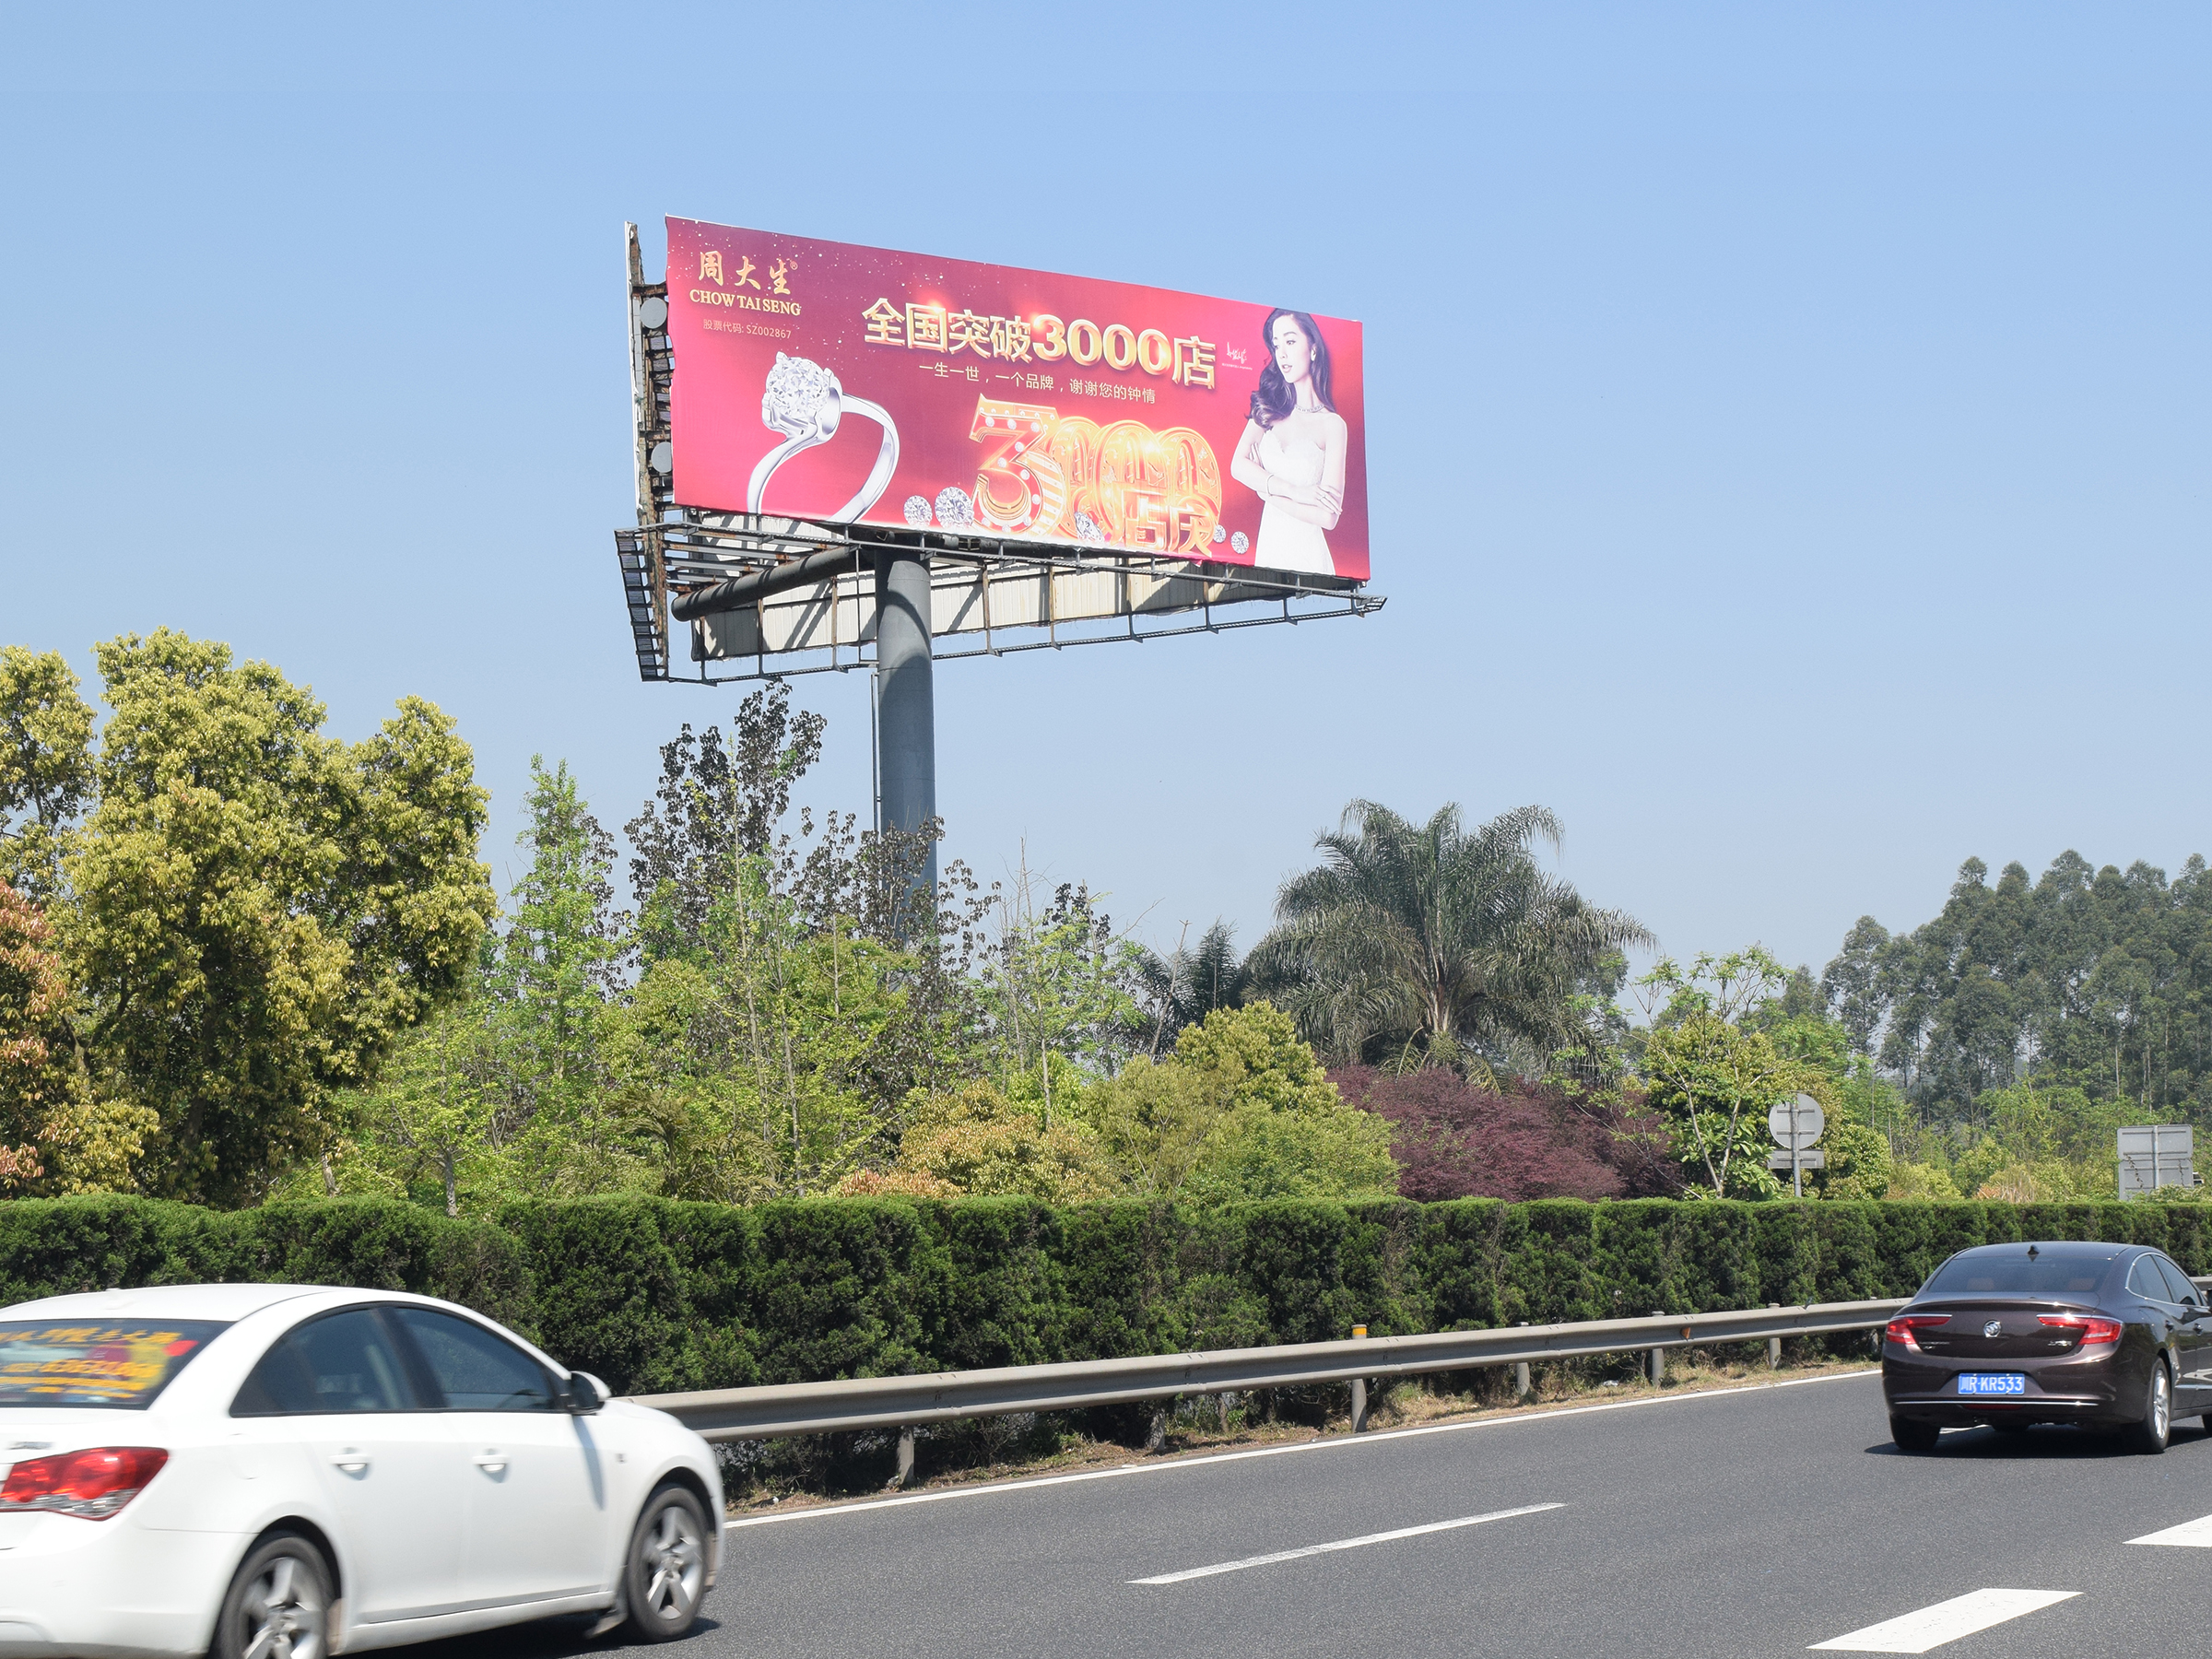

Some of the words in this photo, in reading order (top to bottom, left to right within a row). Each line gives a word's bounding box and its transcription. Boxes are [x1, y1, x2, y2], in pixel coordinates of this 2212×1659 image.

[699, 250, 791, 294] 周大生
[688, 288, 735, 307] CHOW
[736, 295, 761, 311] TAI
[762, 299, 801, 316] SENG
[703, 318, 744, 334] 股票代码:
[746, 324, 792, 339] SZ002867
[862, 297, 1217, 390] 全国突破3000店
